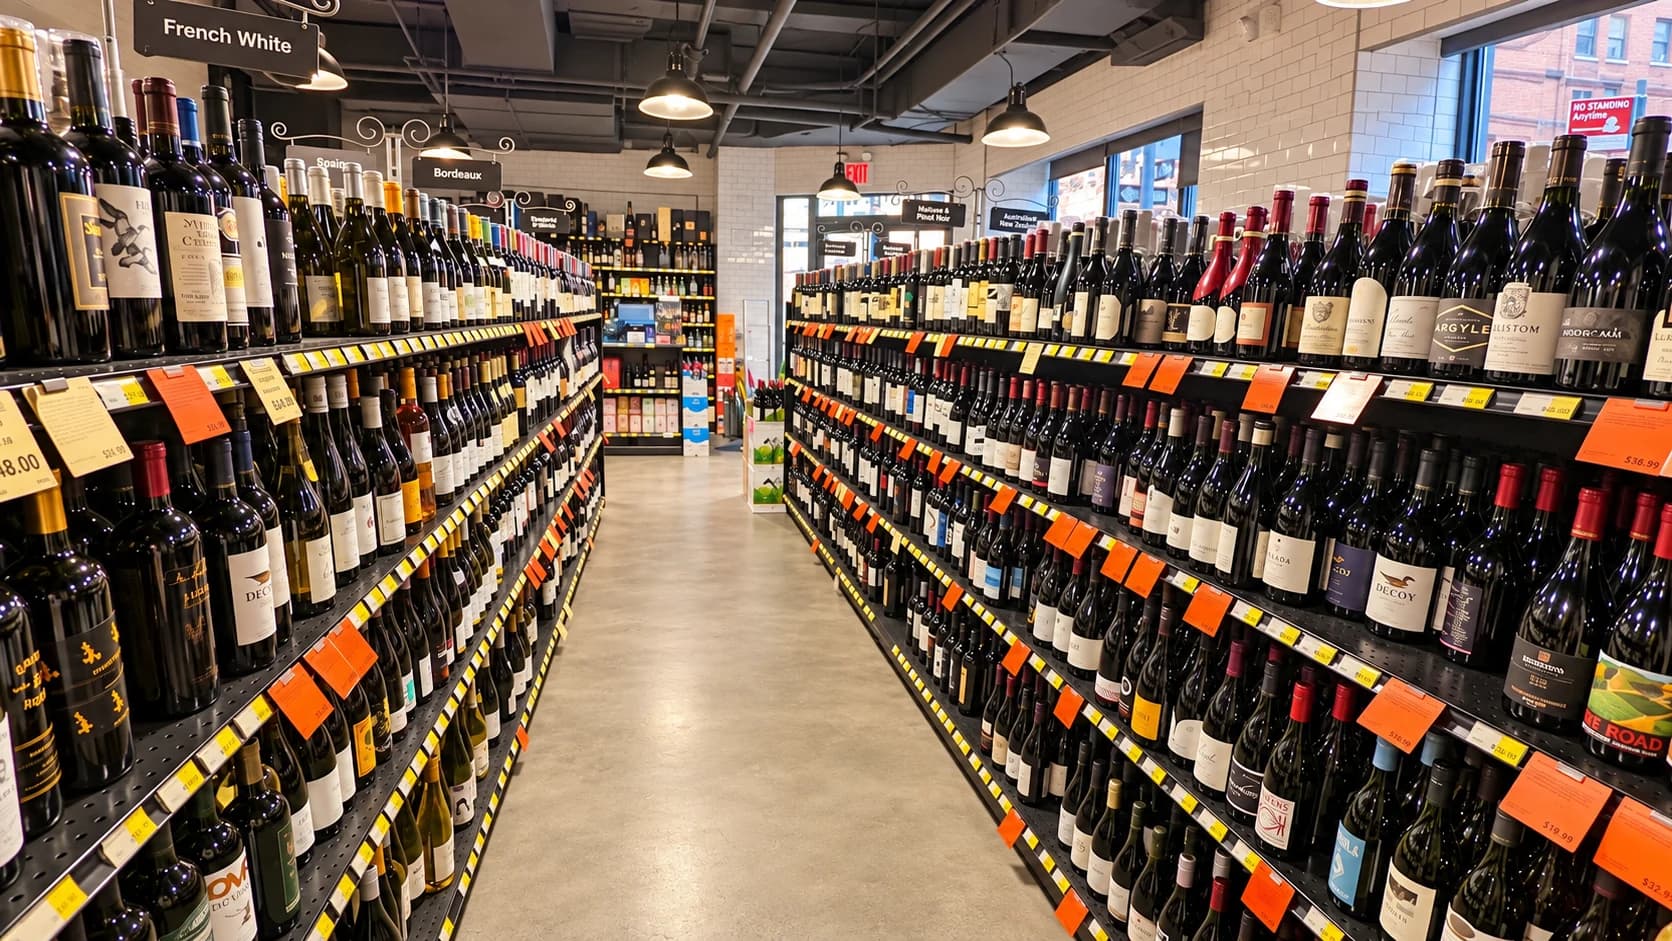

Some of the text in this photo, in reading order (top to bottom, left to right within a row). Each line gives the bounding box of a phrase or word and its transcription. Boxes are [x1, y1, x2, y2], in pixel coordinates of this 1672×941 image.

[163, 18, 292, 54] French White
[1573, 100, 1630, 111] NO STANDING
[1573, 112, 1608, 122] Anytime
[433, 167, 482, 180] Bordeaux
[846, 163, 869, 185] EXIT
[1434, 322, 1491, 336] ARGYLE
[1376, 583, 1417, 602] DECOY
[1605, 723, 1663, 751] ROAD
[1542, 821, 1574, 844] $19.99
[1641, 877, 1672, 902] $32.9
